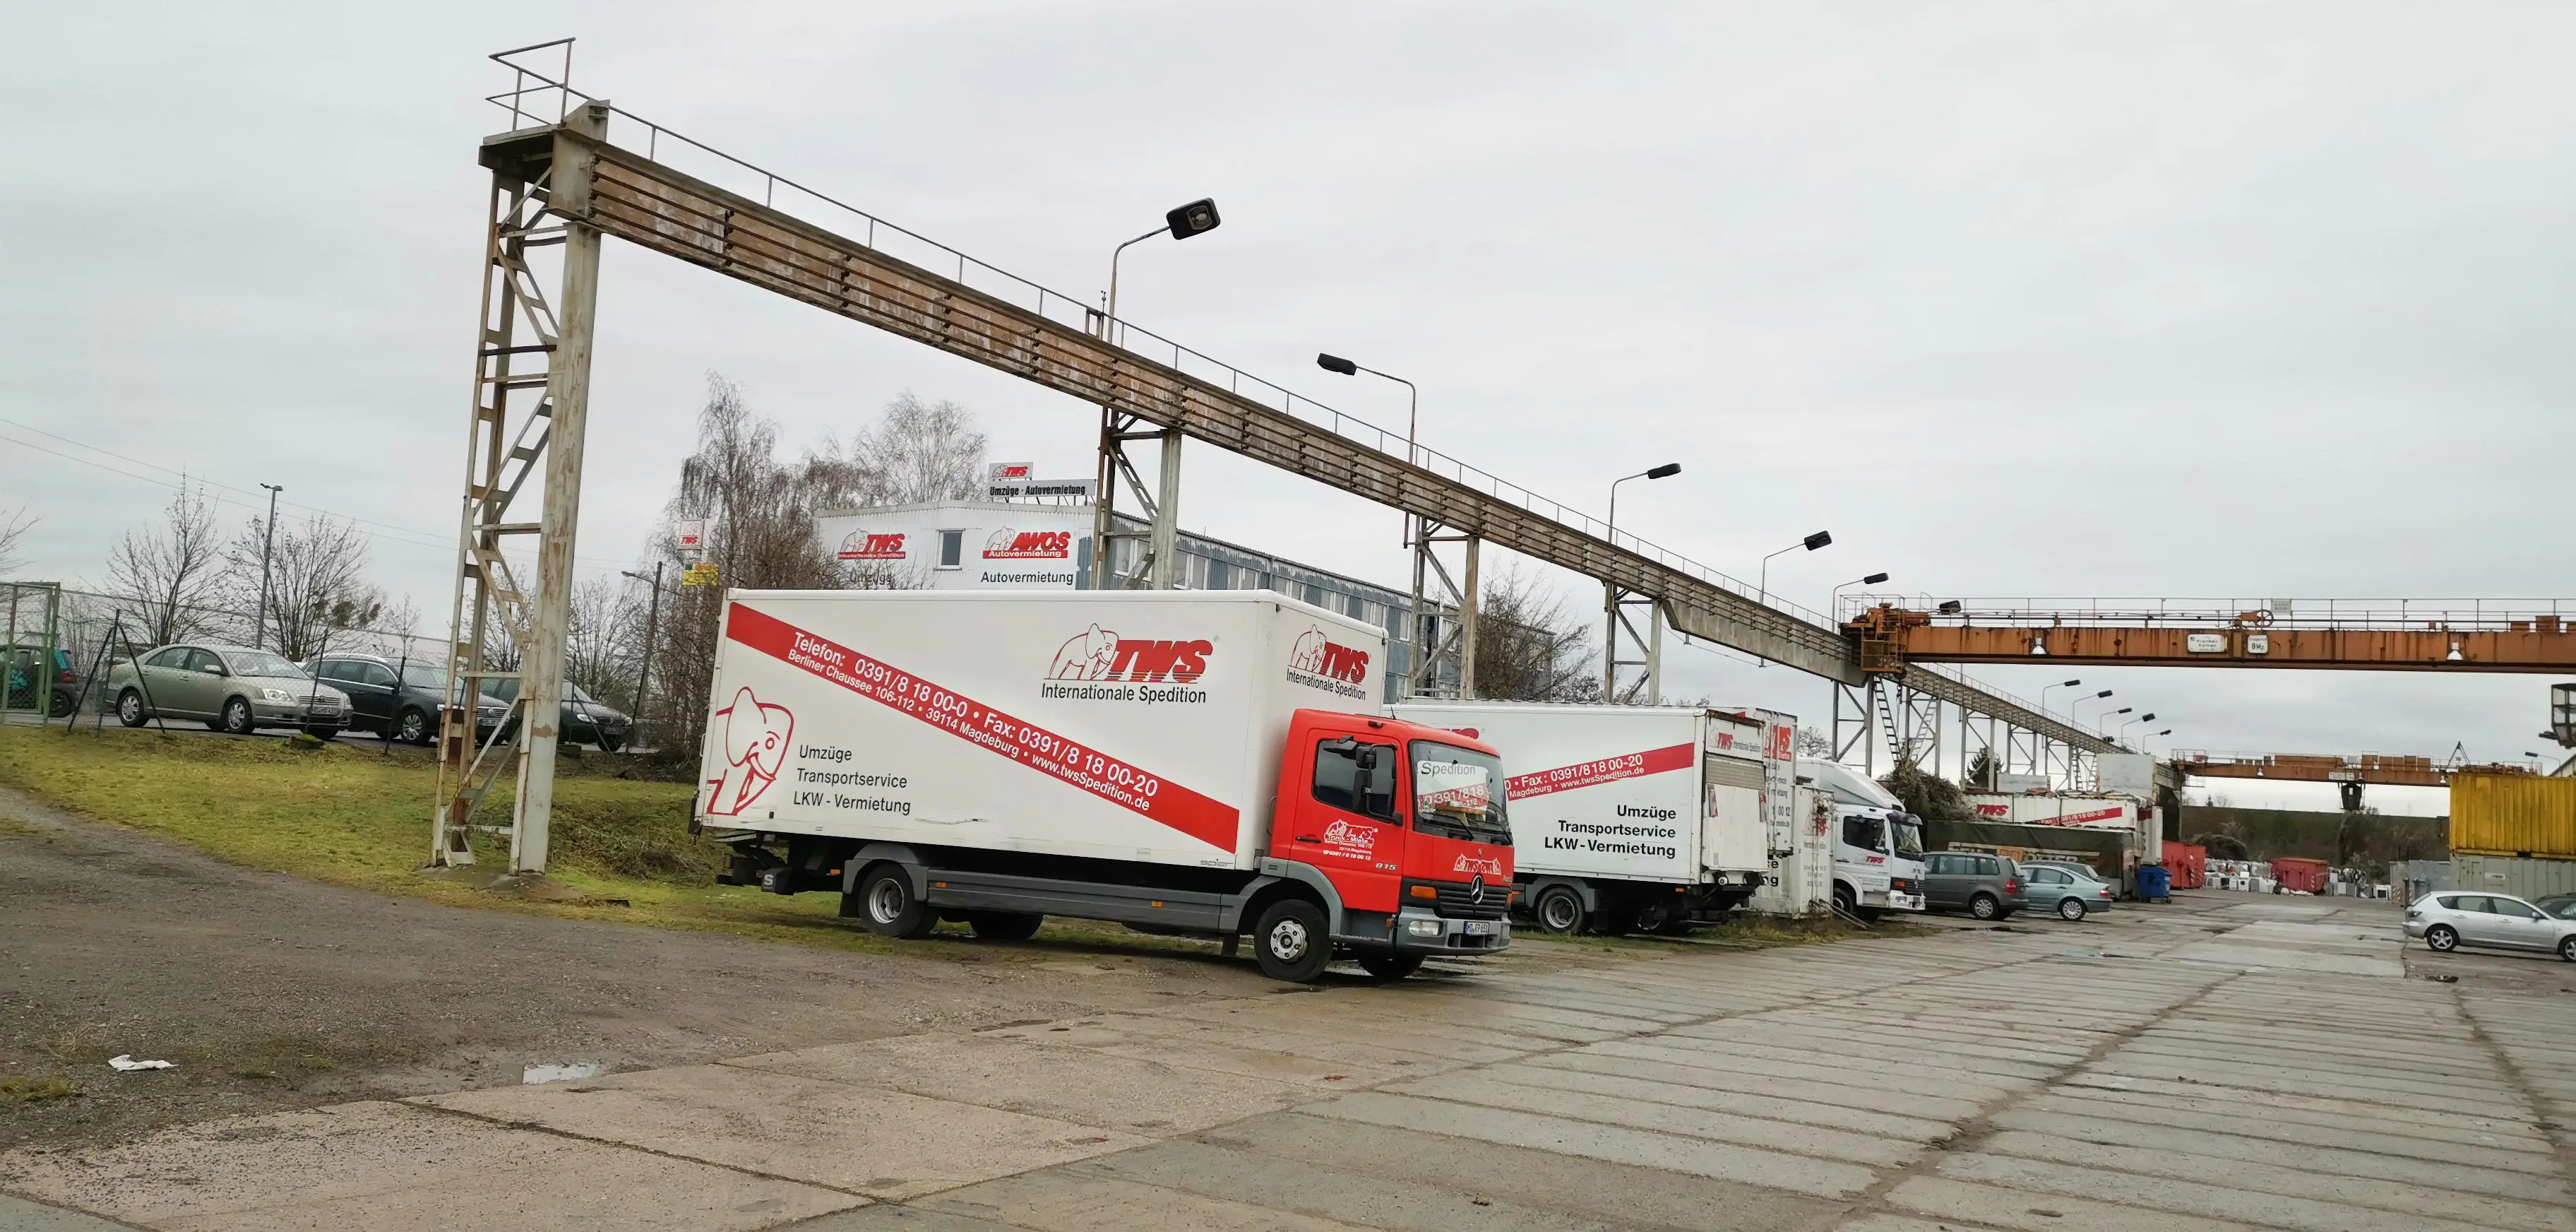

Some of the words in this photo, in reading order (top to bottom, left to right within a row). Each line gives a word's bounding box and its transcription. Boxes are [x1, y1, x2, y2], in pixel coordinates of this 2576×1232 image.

[1004, 466, 1028, 477] TWS
[990, 486, 1019, 497] Umzüge
[1025, 485, 1085, 495] Autovermietung
[863, 533, 905, 552] TWS
[1008, 531, 1071, 550] AWOS
[981, 571, 1073, 586] Autovermietung
[1104, 639, 1213, 684] TWS
[1318, 641, 1369, 685] TWS
[1042, 683, 1135, 701] Internationale
[1139, 685, 1206, 704] Spedition
[1287, 668, 1334, 692] Internationale
[1335, 681, 1366, 701] Spedition
[794, 632, 846, 667] Telefon:
[854, 658, 909, 693] 0391/8
[913, 682, 931, 701] 18
[933, 691, 968, 718] 00-0
[984, 712, 1016, 738] Fax:
[1019, 728, 1080, 764] 0391/8
[1085, 754, 1104, 774] 18
[1108, 764, 1158, 797] 00-20
[788, 648, 825, 673] Berliner
[826, 665, 872, 693] Chaussee
[876, 686, 914, 711] 106-112
[926, 707, 959, 730] 39114
[959, 721, 1020, 758] Magdeburg
[1032, 754, 1150, 811] www.twsSpedition.de
[799, 745, 852, 763] Umzüge
[1608, 754, 1643, 771] 00-20
[797, 768, 907, 788] Transportservice
[1421, 762, 1476, 777] Spedition
[1508, 785, 1552, 799] Magdeburg
[1561, 766, 1645, 788] www.twsSpedition.de
[1617, 804, 1676, 822] Umzüge
[1975, 805, 2009, 815] TWS
[1558, 819, 1676, 838] Transportservice
[1200, 858, 1234, 867] spier
